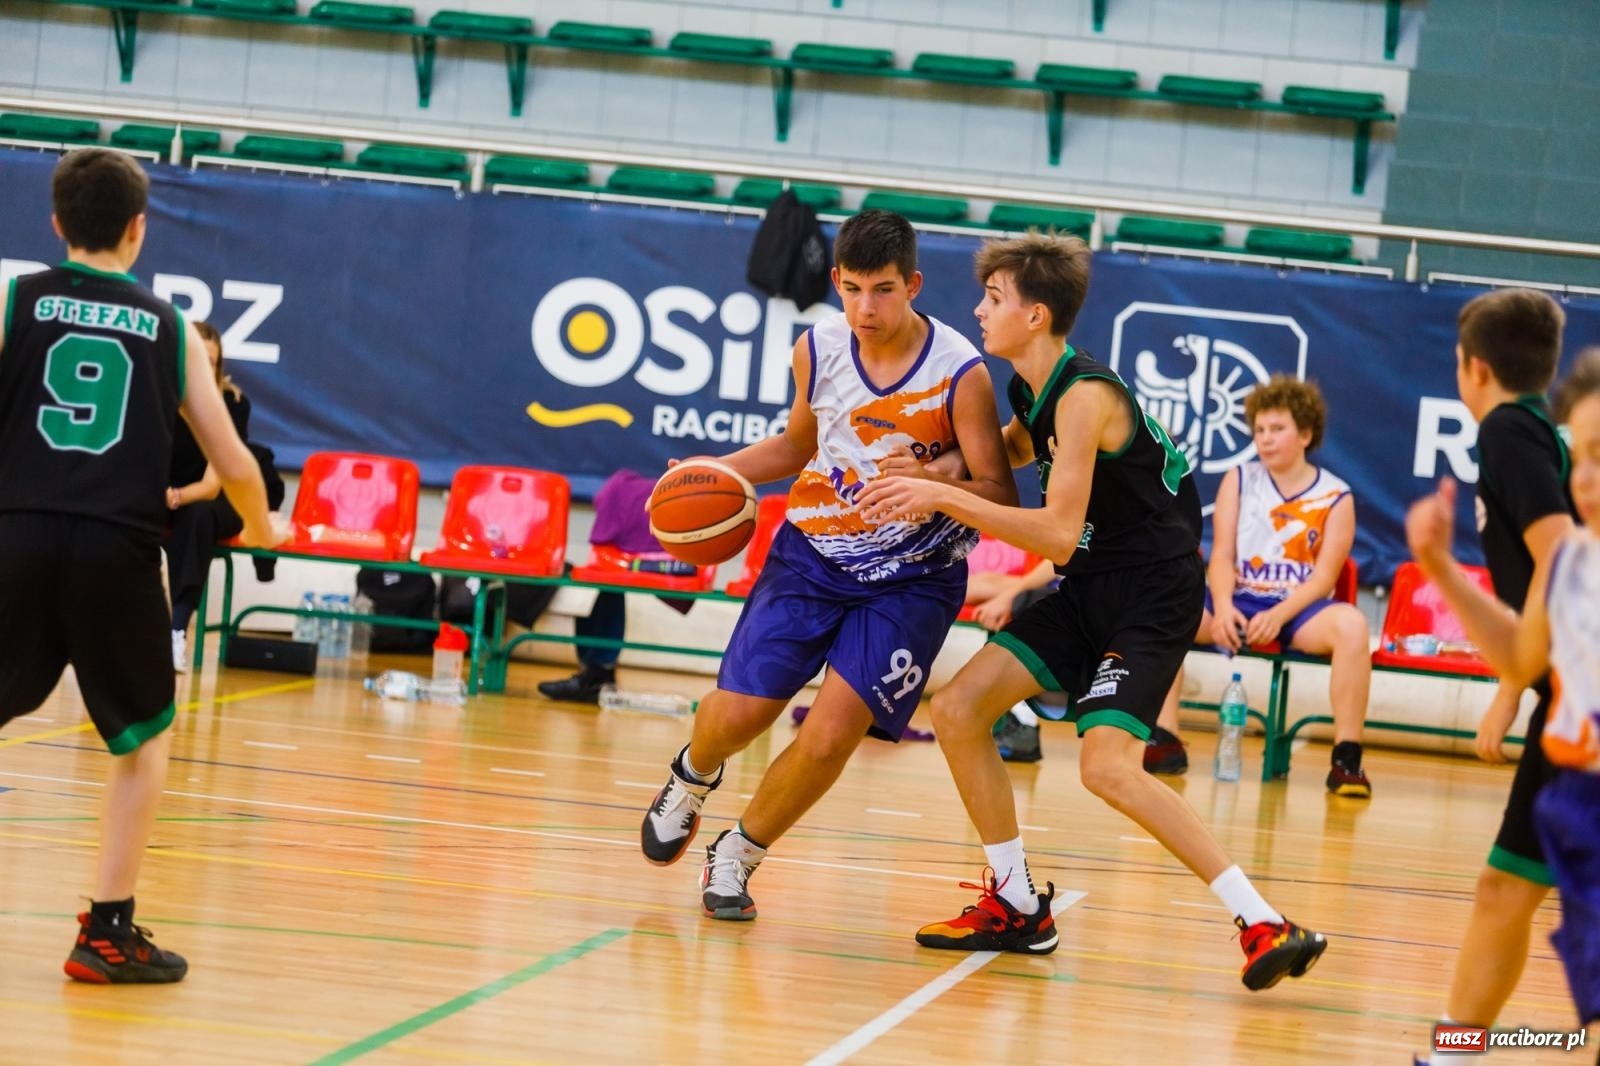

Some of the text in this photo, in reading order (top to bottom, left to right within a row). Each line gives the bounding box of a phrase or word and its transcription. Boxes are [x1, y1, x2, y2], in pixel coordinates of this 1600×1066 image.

[34, 295, 160, 342] STEFAN
[37, 331, 133, 455] 9
[658, 472, 718, 497] molten
[880, 648, 923, 700] 99
